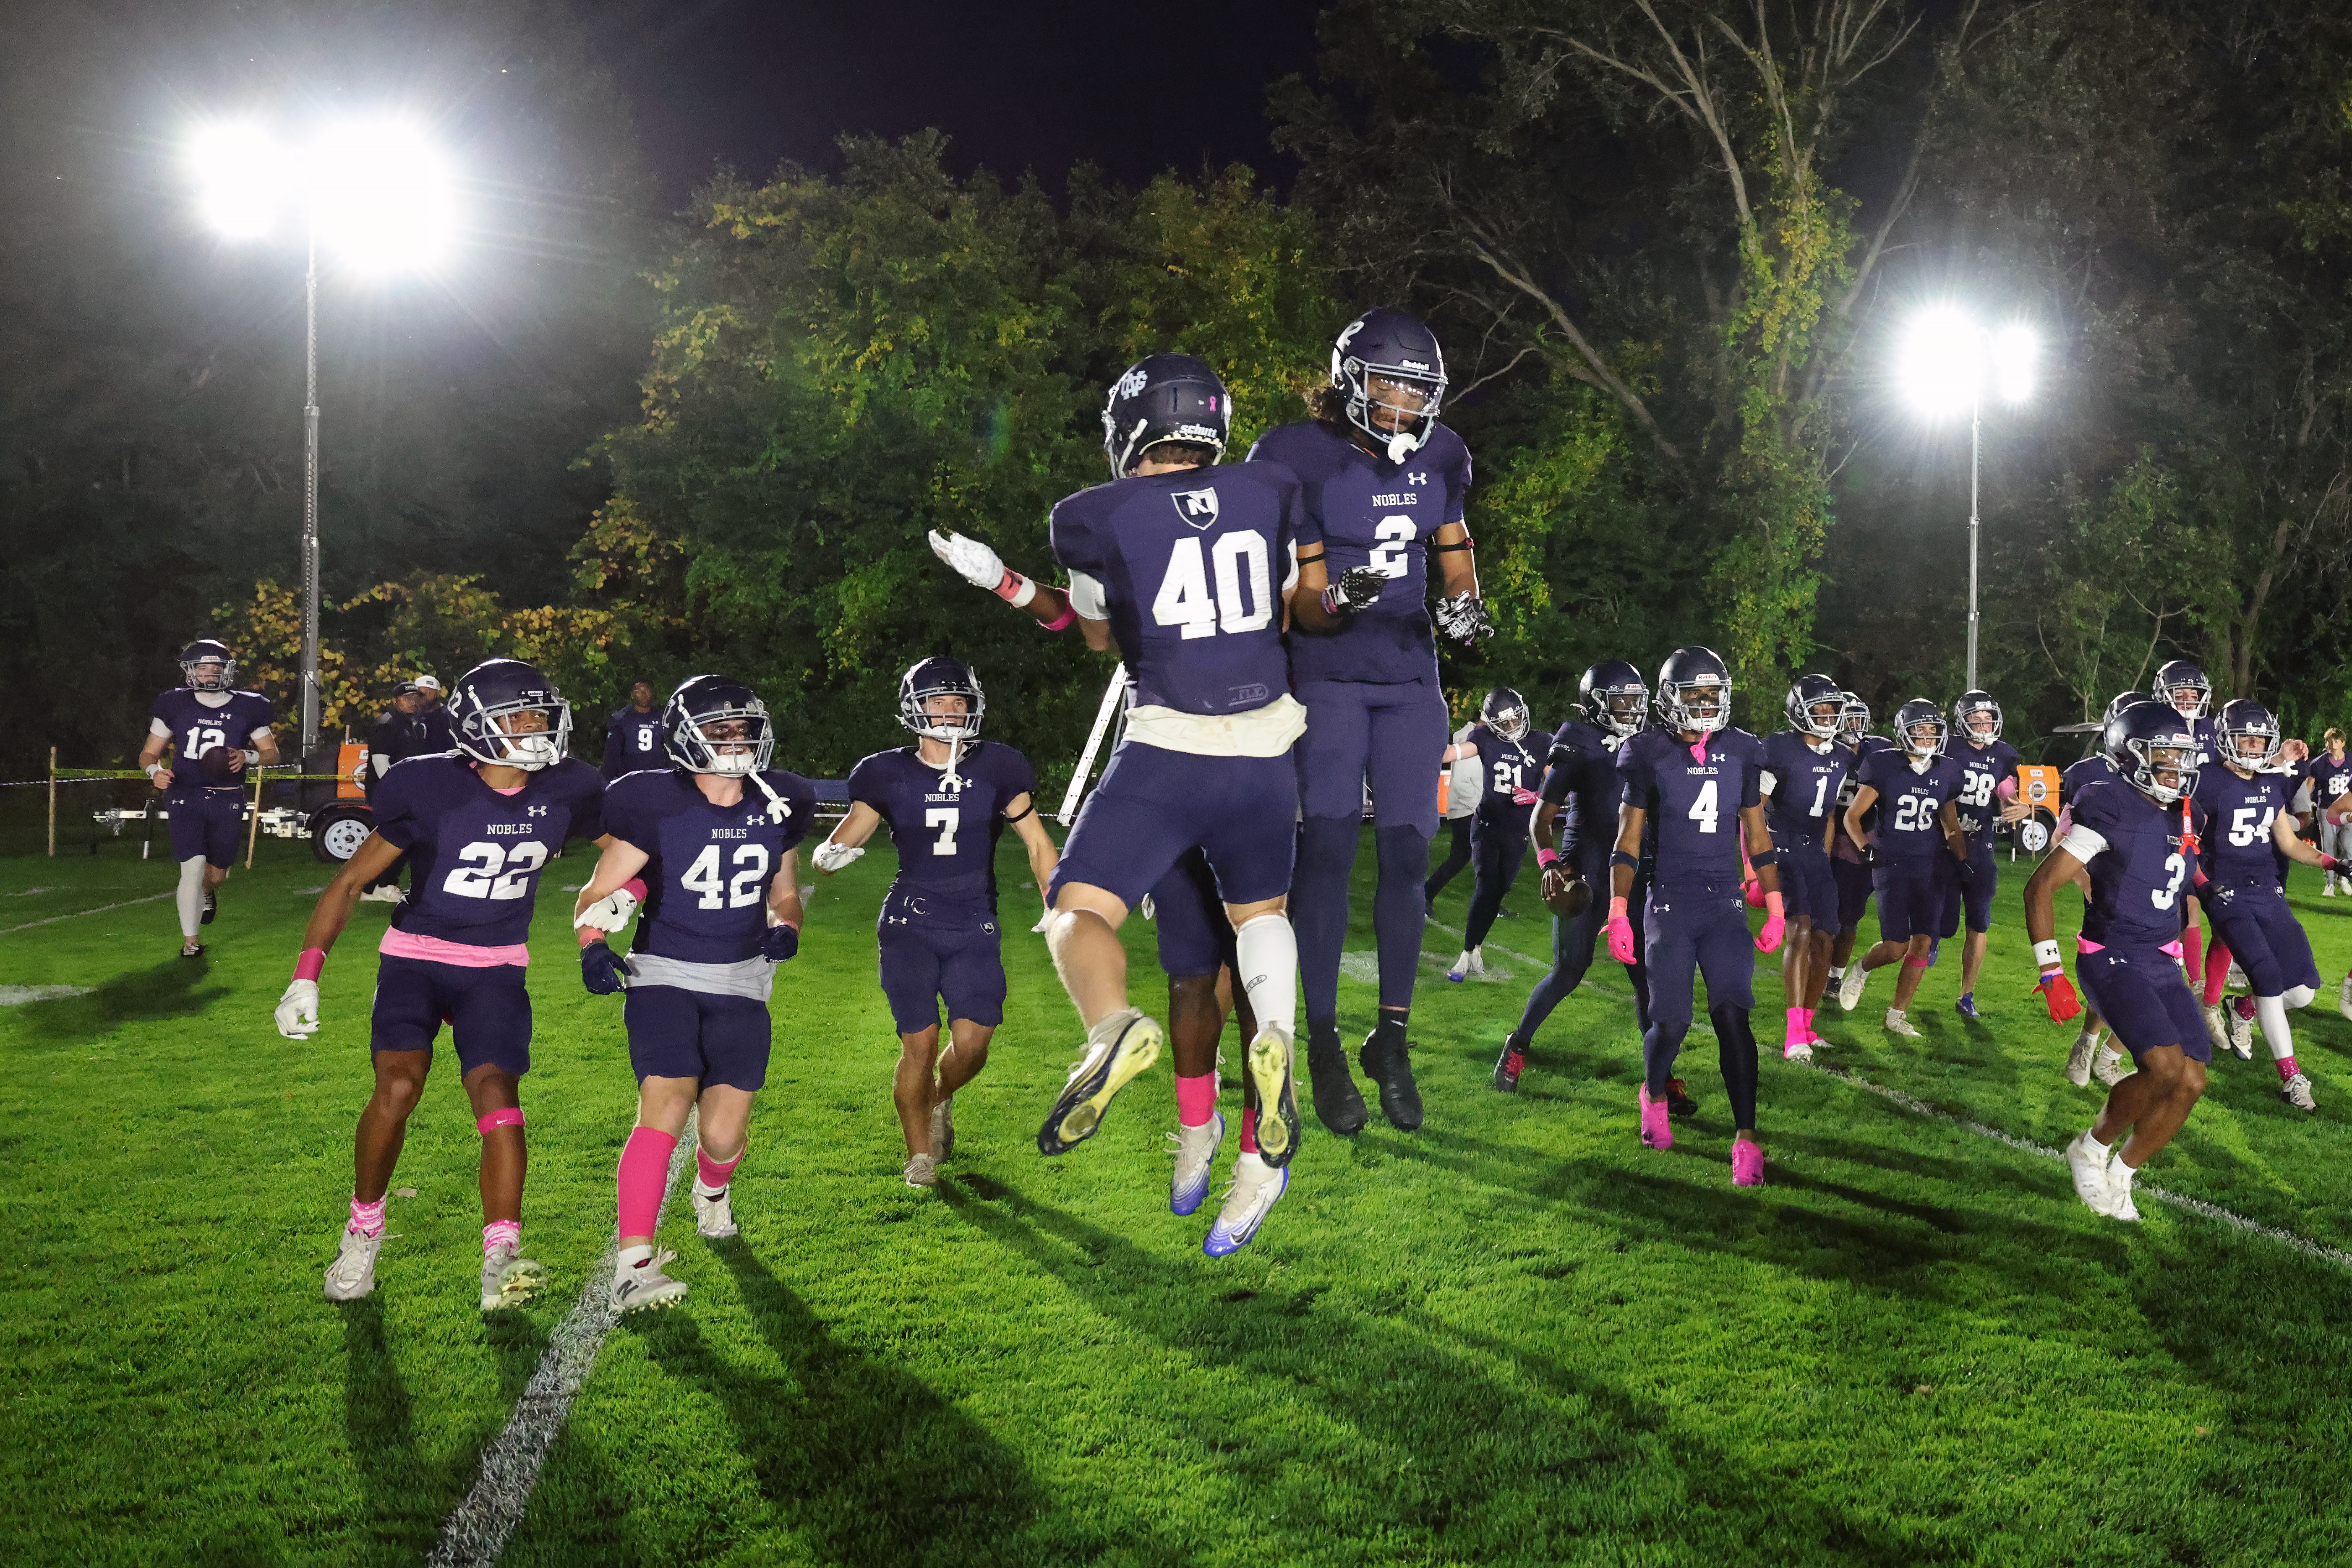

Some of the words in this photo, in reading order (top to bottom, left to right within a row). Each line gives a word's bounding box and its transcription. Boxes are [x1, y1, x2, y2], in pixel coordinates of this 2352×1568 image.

[1180, 423, 1218, 438] schutt
[1372, 493, 1417, 506] NOBLES
[1369, 515, 1417, 579] 2
[1152, 529, 1273, 640] 40
[184, 726, 226, 760] 12
[638, 728, 653, 751] 9
[1493, 761, 1522, 795] 21
[1687, 767, 1718, 775] NOBLES
[1970, 762, 1989, 770] NOBLES
[924, 794, 960, 802] NOBLES
[1809, 775, 1828, 817] 1
[1911, 787, 1929, 796] NOBLES
[1955, 769, 1996, 807] 28
[2329, 776, 2350, 795] 88
[1689, 780, 1719, 833] 4
[1895, 794, 1939, 831] 26
[487, 824, 533, 835] NOBLES
[712, 829, 747, 839] NOBLES
[925, 808, 959, 855] 7
[2229, 806, 2274, 847] 54
[443, 841, 548, 900] 22
[681, 844, 769, 910] 42
[2151, 853, 2186, 910] 3
